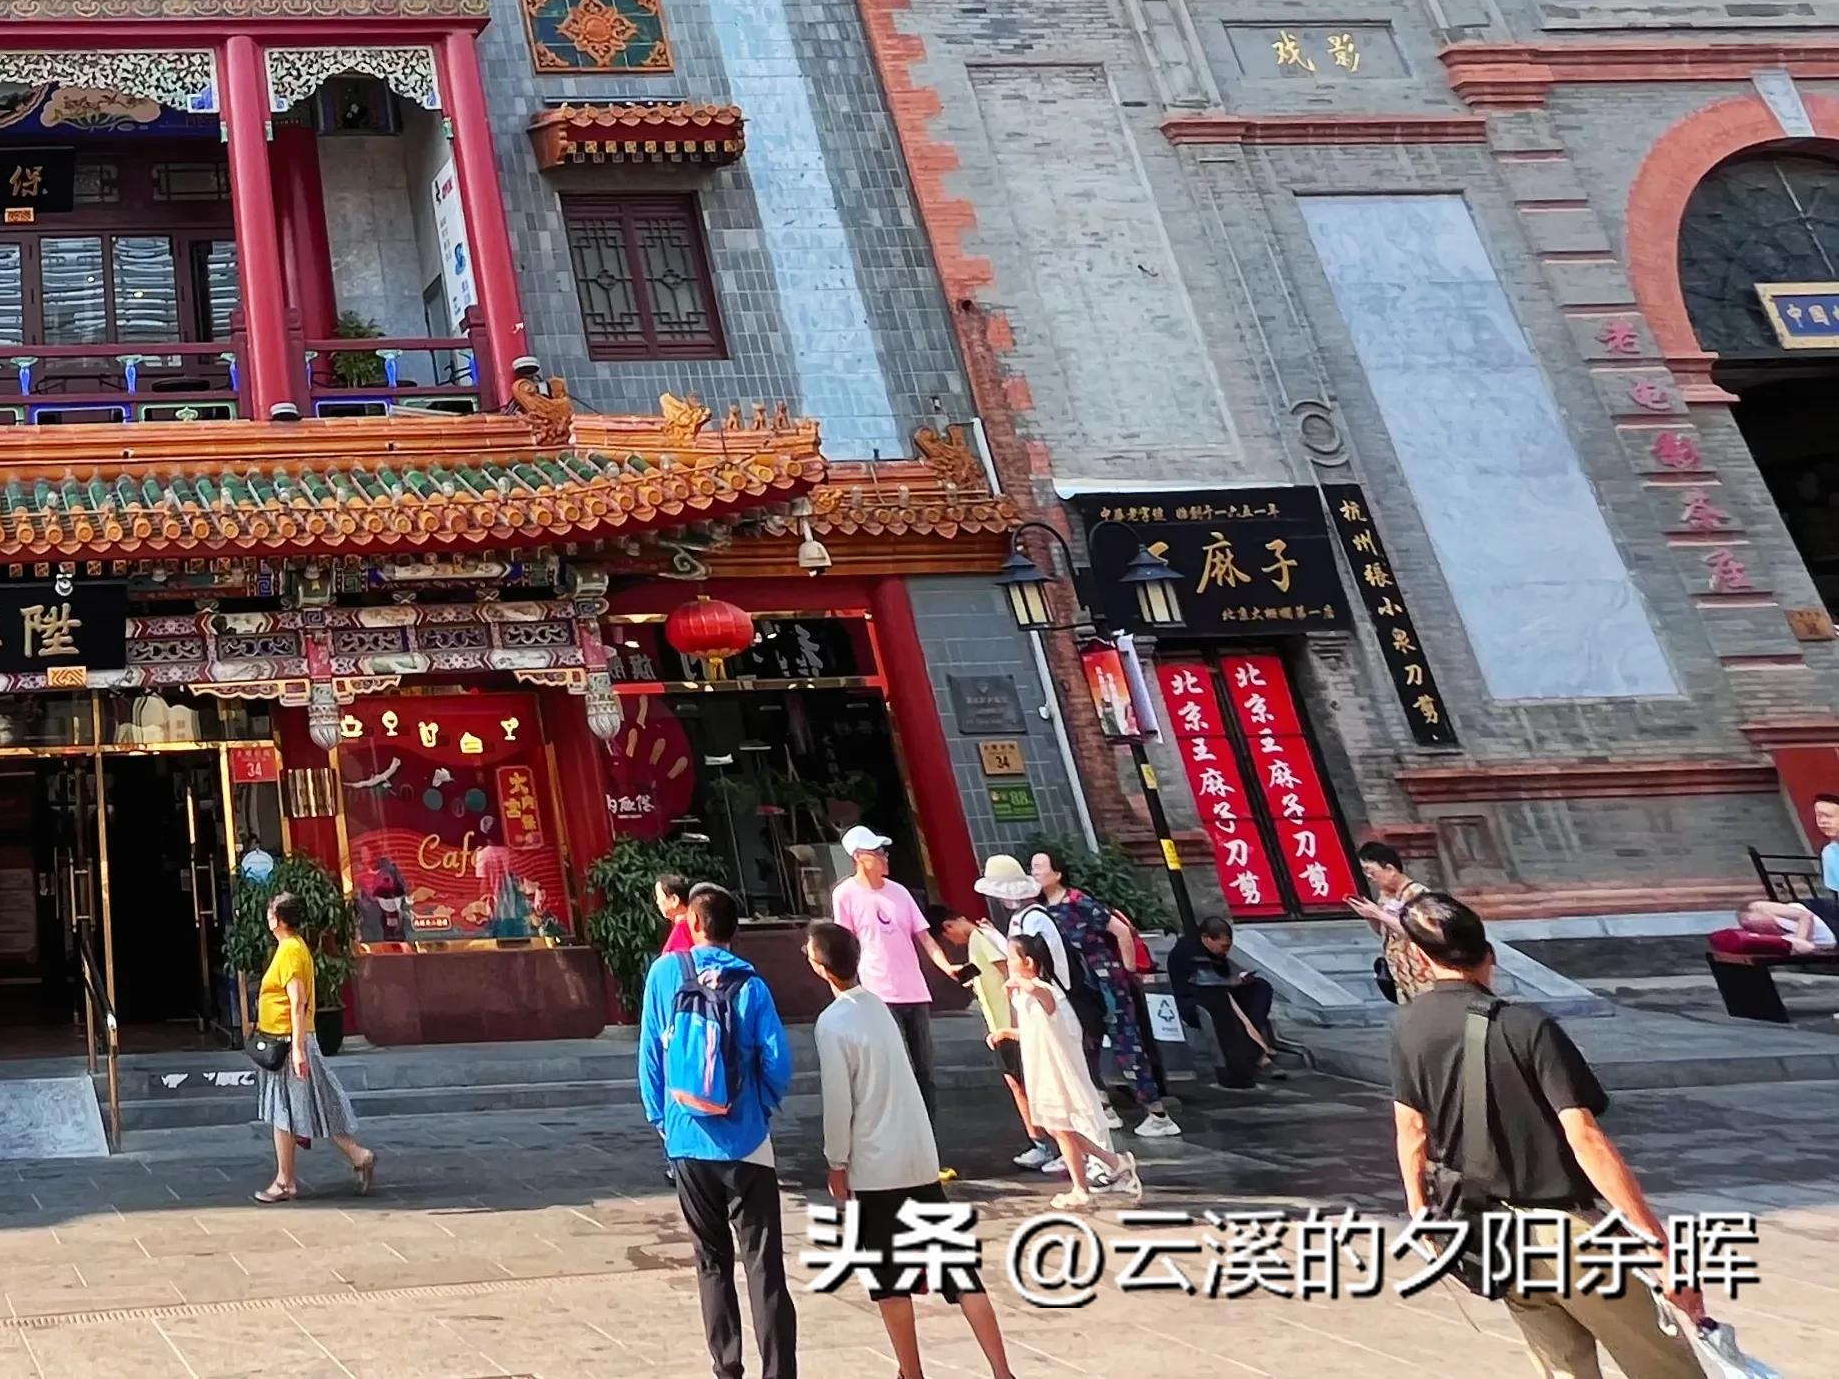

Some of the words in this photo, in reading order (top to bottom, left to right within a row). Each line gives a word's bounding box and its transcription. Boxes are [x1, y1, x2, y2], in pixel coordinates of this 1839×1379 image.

[1785, 303, 1839, 328] 中国
[246, 762, 263, 778] 34
[1169, 669, 1262, 905] 北京王麻子刀剪
[1234, 661, 1330, 898] 北京王麻子刀剪
